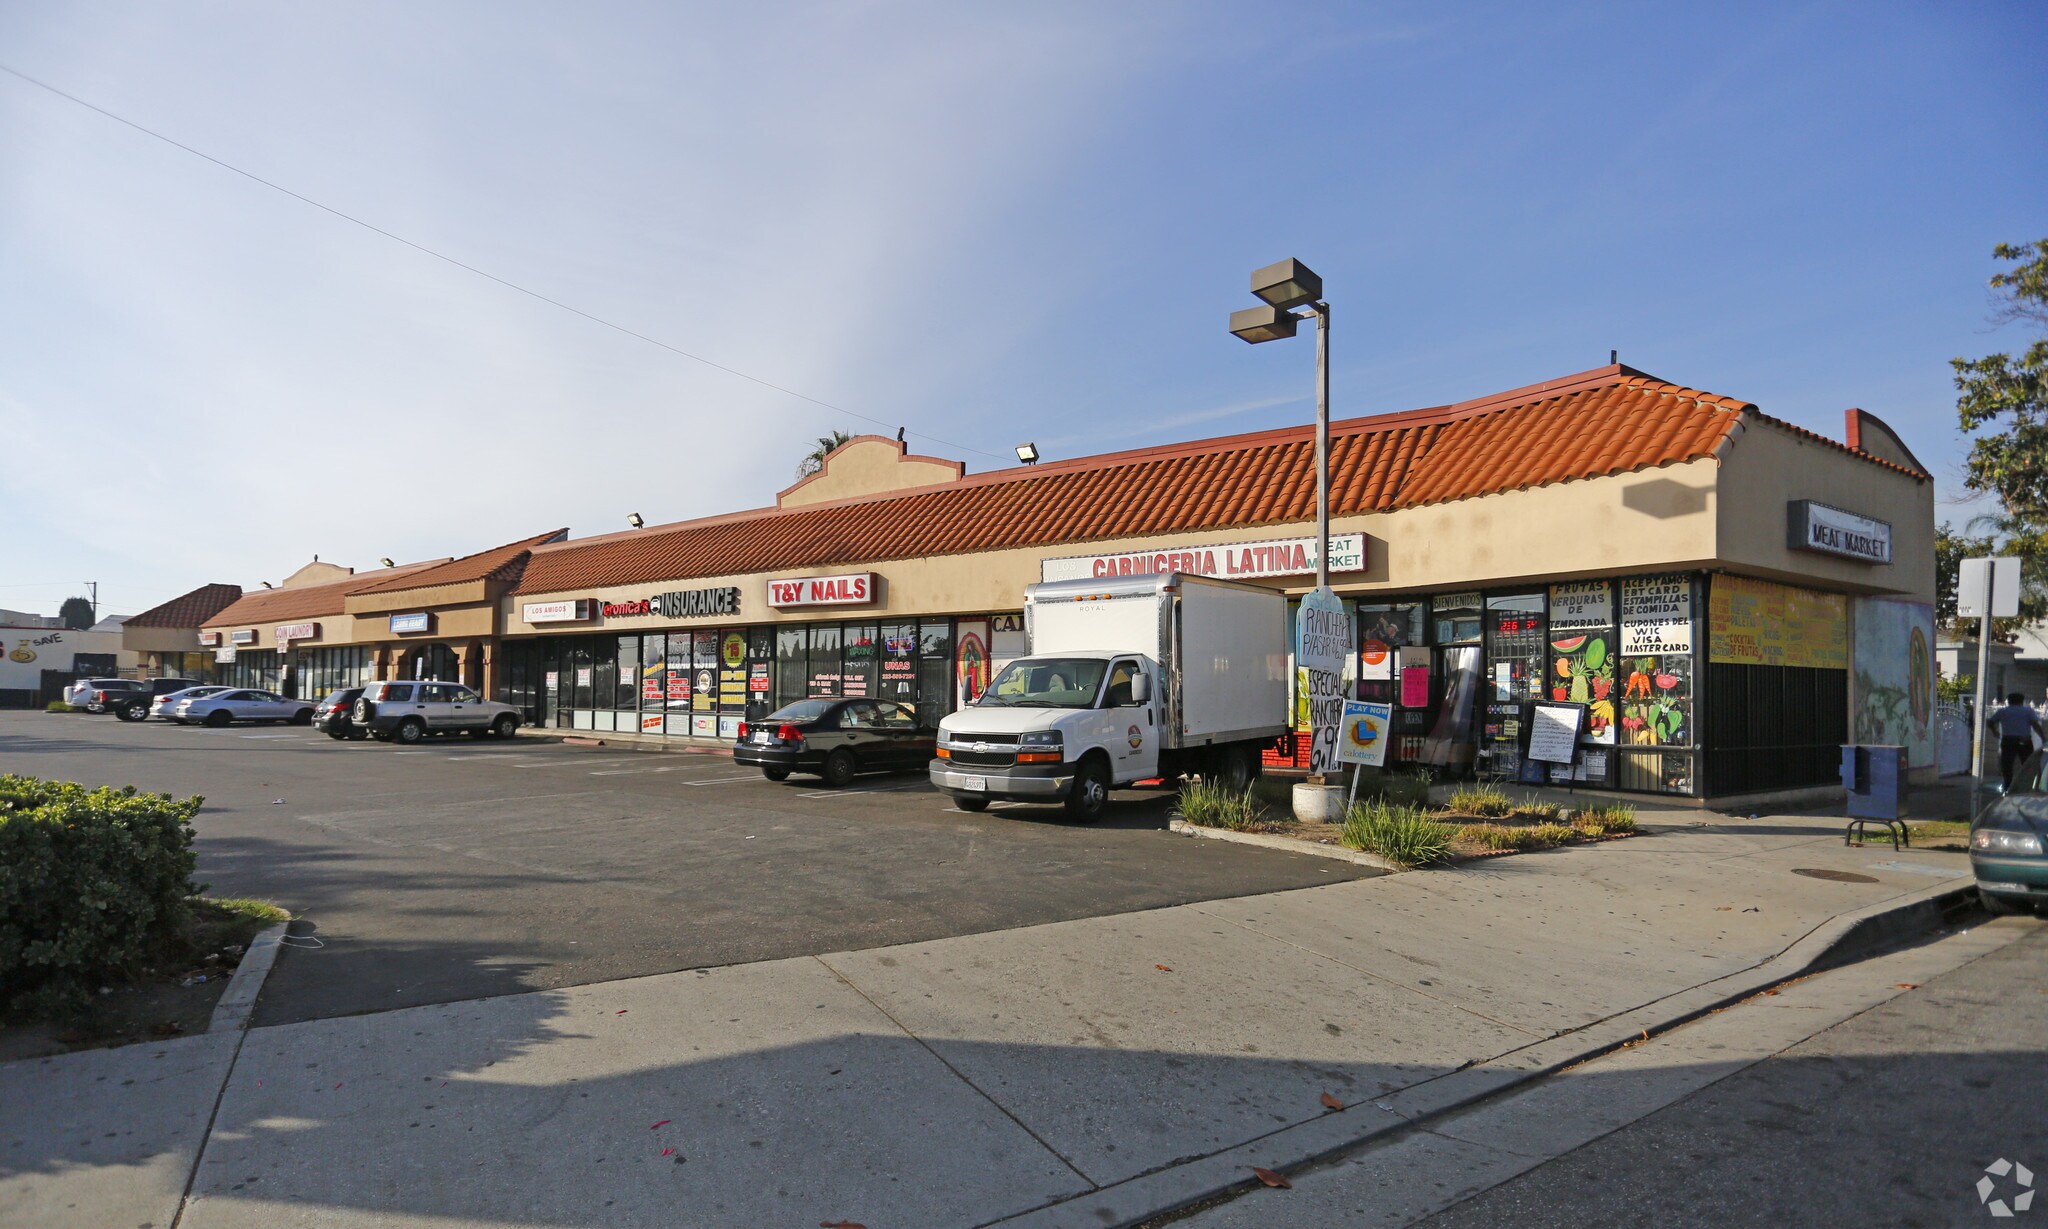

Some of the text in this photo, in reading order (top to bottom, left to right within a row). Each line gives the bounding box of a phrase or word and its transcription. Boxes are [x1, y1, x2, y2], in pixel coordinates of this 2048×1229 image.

[1314, 539, 1352, 553] EAT
[1813, 523, 1886, 557] MEAT MARKET
[1056, 561, 1077, 572] LOS
[1093, 543, 1308, 579] CARNICERIA LATINA
[1306, 554, 1360, 569] MRKET
[1555, 581, 1603, 595] FRUTAS
[1623, 575, 1689, 589] ACEPTAMOS
[772, 577, 867, 603] T&Y NAILS
[1623, 585, 1680, 597] EBT CARD
[597, 587, 736, 616] Veronica's INSURANCE
[1433, 594, 1481, 608] BIENVENIDOS
[1551, 593, 1605, 607] VERDURAS
[1623, 593, 1689, 606] ESTAMPILLAS
[544, 605, 567, 614] AMIGOS
[1568, 605, 1583, 615] DE
[1623, 603, 1680, 615] DE COMIDA
[1550, 618, 1607, 629] TEMPORADA
[1623, 616, 1689, 628] CUPONES DEL
[288, 623, 313, 638] LAUNDRY
[1634, 627, 1660, 636] WIC
[33, 632, 63, 647] SAVE
[1632, 635, 1662, 644] VISA
[1309, 668, 1344, 697] ESPECIAL
[1346, 704, 1389, 715] PLAY NOW
